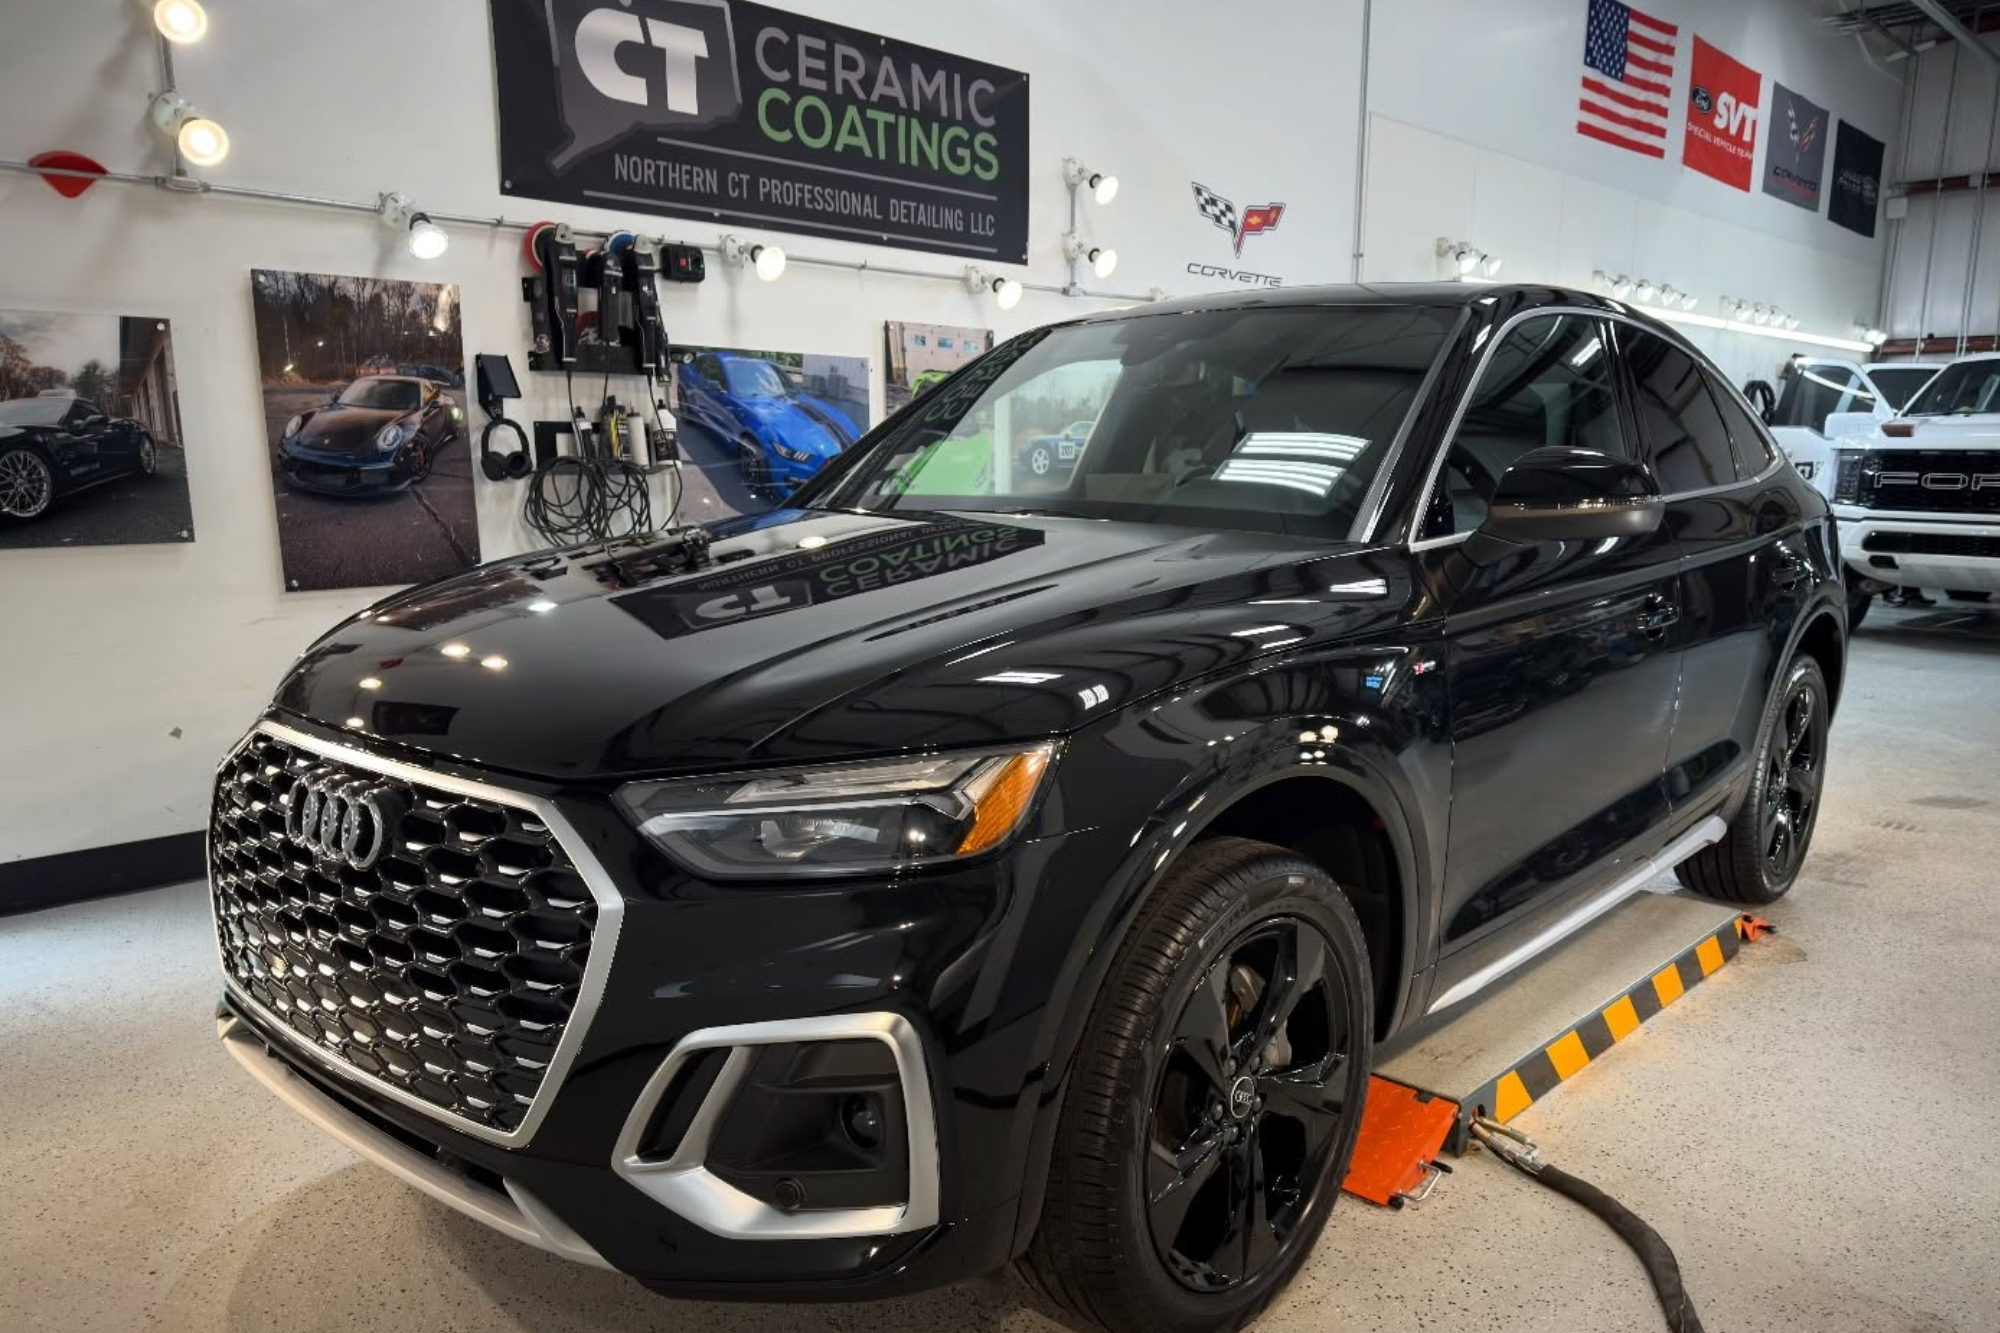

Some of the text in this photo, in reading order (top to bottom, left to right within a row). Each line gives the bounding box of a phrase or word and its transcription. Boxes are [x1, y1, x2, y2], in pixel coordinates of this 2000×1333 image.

[574, 8, 709, 115] CT
[755, 26, 995, 127] CERAMIC
[758, 87, 999, 181] COATINGS
[1687, 121, 1712, 143] SPECIAL
[1713, 135, 1736, 155] VEHICLE
[1713, 91, 1758, 142] SVT
[614, 153, 995, 236] NORTHERN CT PROFESSIONAL DETAILING LLC
[1187, 262, 1284, 288] CORVETTE
